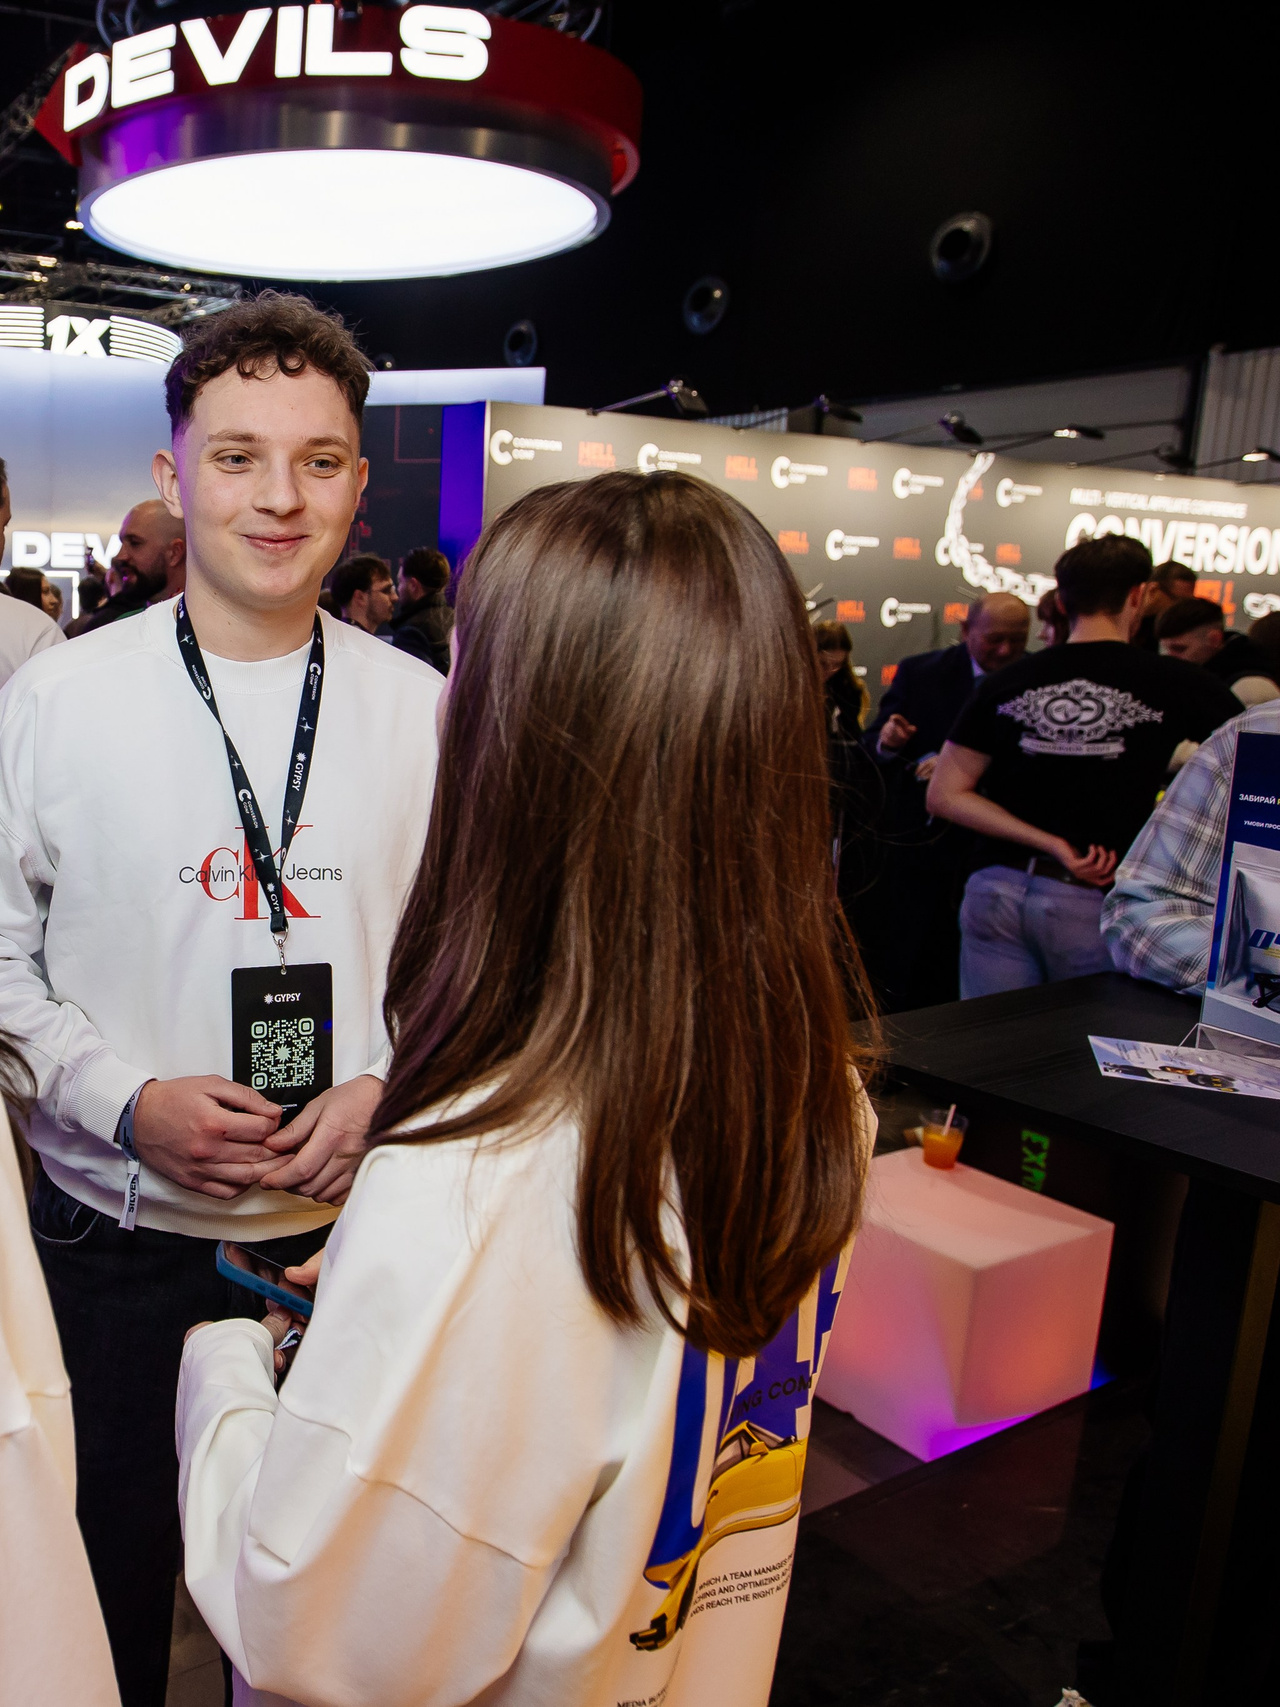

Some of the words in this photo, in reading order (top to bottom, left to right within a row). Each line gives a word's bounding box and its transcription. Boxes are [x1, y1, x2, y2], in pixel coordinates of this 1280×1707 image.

[63, 4, 492, 133] DEVILS
[292, 763, 304, 791] GYPSY
[1239, 793, 1276, 805] ЗАБИРАЙ
[179, 866, 235, 884] Calvin
[286, 863, 343, 881] Jeans
[274, 993, 301, 1003] GYPSY
[718, 1584, 736, 1595] AND
[736, 1573, 781, 1592] OPTIMIZING
[730, 1569, 753, 1580] TEAM
[706, 1596, 733, 1610] REACH
[734, 1594, 751, 1604] THE
[752, 1587, 775, 1601] RIGHT
